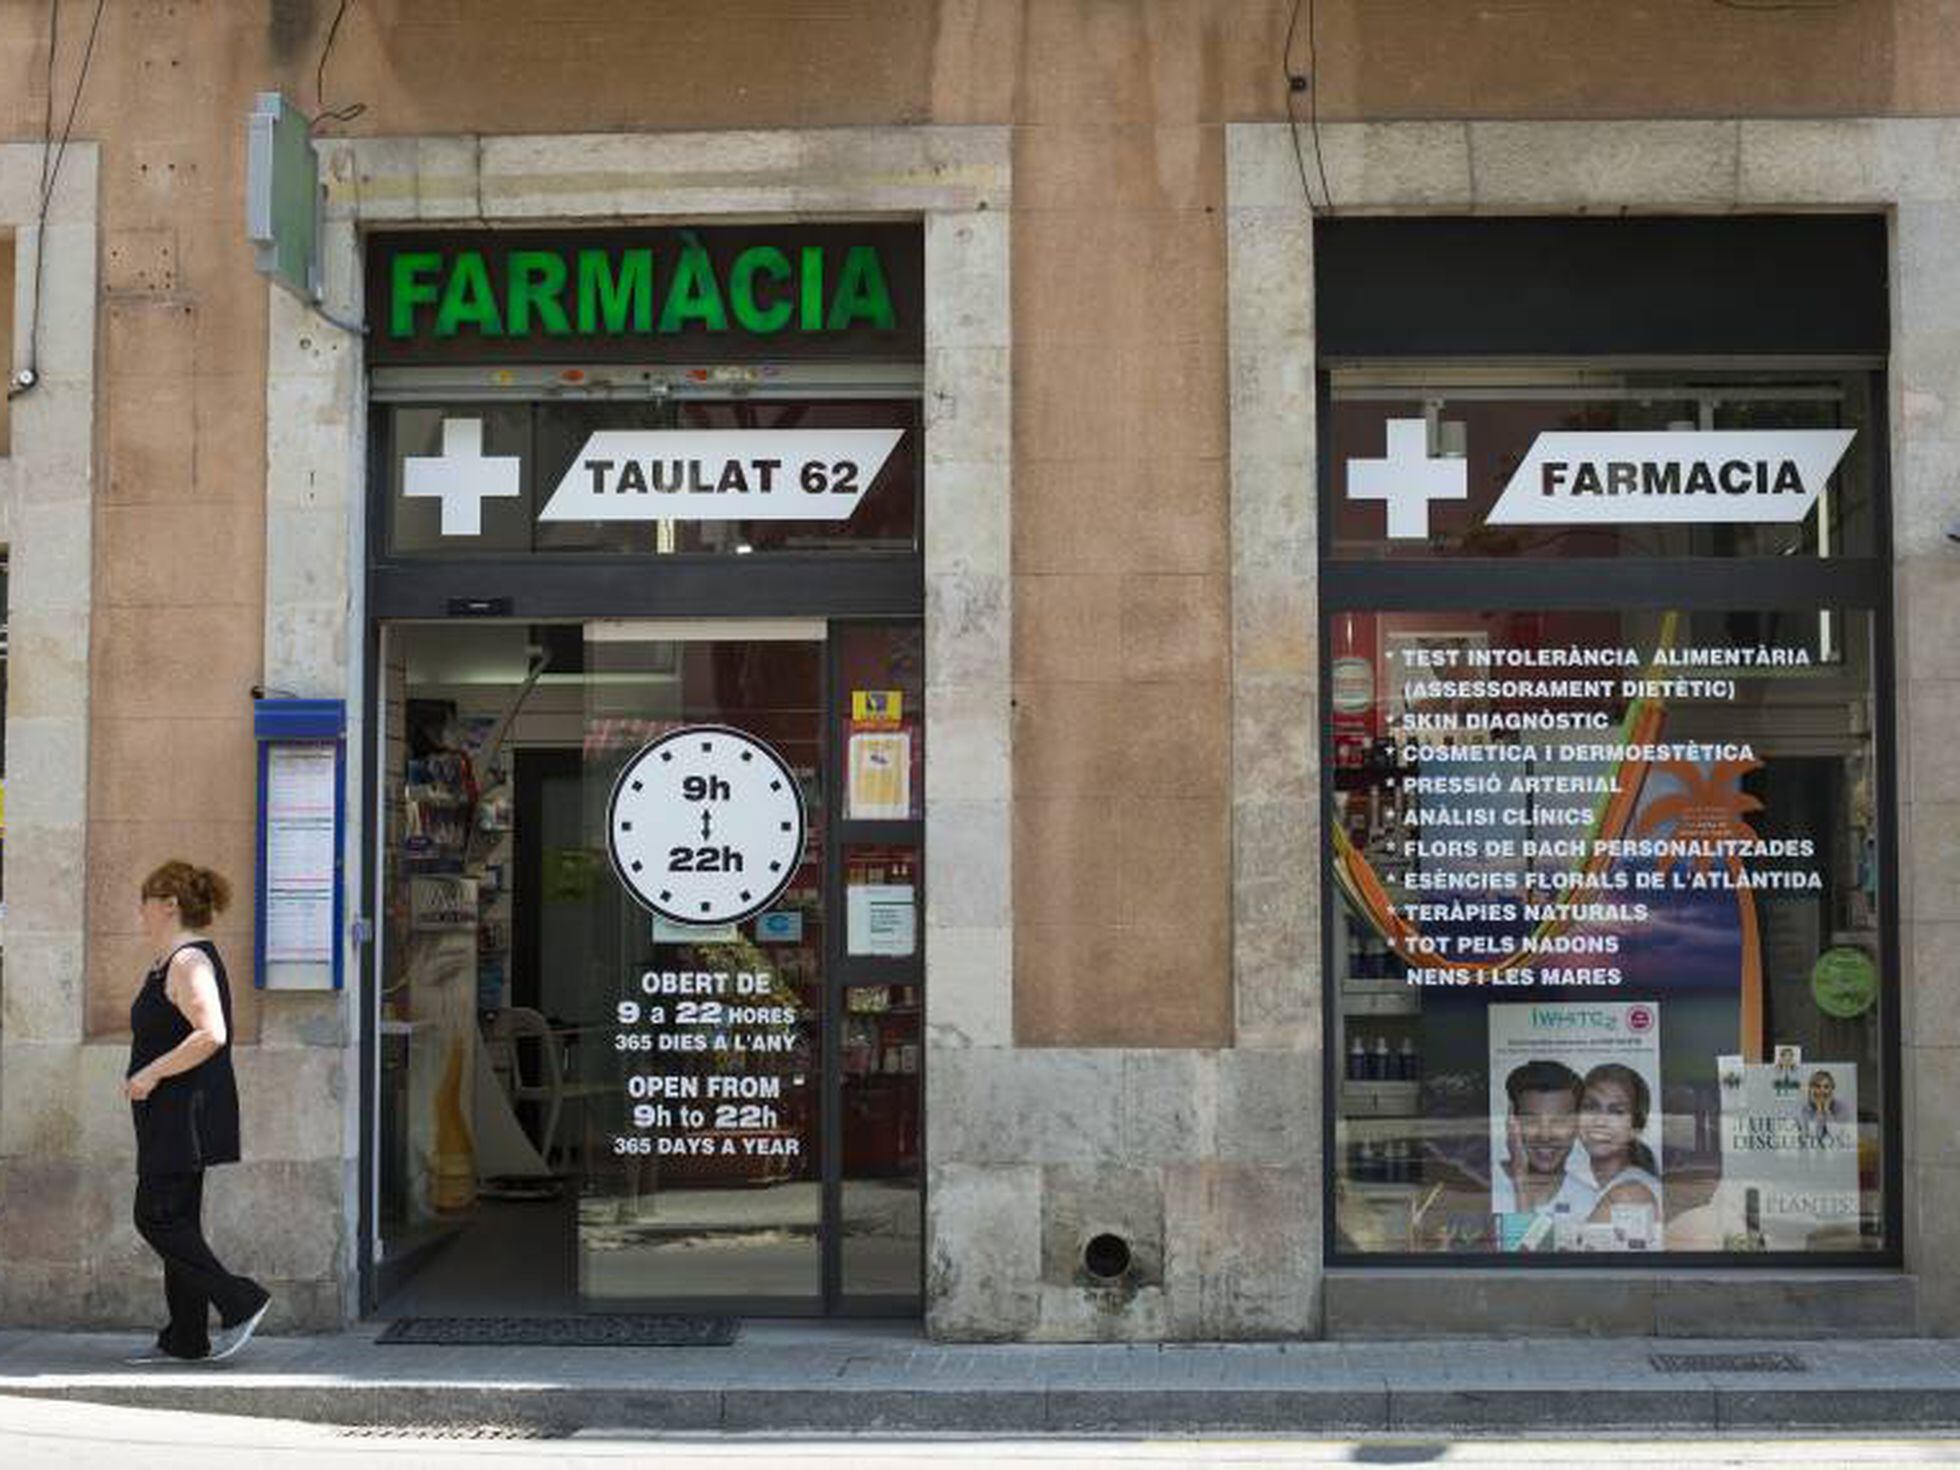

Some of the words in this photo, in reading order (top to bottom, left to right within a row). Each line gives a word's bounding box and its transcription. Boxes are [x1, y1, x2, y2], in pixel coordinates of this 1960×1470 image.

[389, 232, 897, 337] FARMÀCIA
[585, 460, 782, 494] TAULAT
[799, 461, 859, 494] 62
[1541, 460, 1806, 497] FARMACIA
[1402, 649, 1459, 667] TEST
[1468, 645, 1639, 667] INTOLERÀNCIA
[1653, 644, 1811, 666] ALIMENTÀRIA
[1404, 680, 1615, 700] (ASSESSORAMENT
[1622, 675, 1735, 700] DIETÈTIC)
[1402, 713, 1458, 730] SKIN
[1466, 708, 1609, 730] DIAGNÒSTIC
[1402, 744, 1537, 762] COSMETICA
[1545, 745, 1553, 761] I
[1559, 740, 1756, 762] DERMOESTÈTICA
[682, 774, 731, 801] 9h
[1402, 771, 1500, 794] PRESSIÓ
[1509, 775, 1622, 793] ARTERIAL
[1403, 803, 1496, 826] ANÀLISI
[1502, 803, 1596, 826] CLÍNICS
[1403, 840, 1478, 857] FLORS
[1486, 840, 1516, 857] DE
[1522, 840, 1586, 857] BACH
[1593, 839, 1815, 857] PERSONALITZADES
[668, 846, 744, 873] 22h
[1525, 872, 1628, 889] FLORALS
[1636, 872, 1665, 889] DE
[1673, 867, 1823, 889] L'ATLÀNTIDA
[1404, 900, 1517, 921] TERÀPIES
[1524, 904, 1649, 921] NATURALS
[1404, 936, 1451, 954] TOT
[1457, 936, 1515, 954] PELS
[1522, 936, 1620, 954] NADONS
[641, 972, 729, 994] OBERT
[736, 972, 772, 994] DE
[1406, 968, 1471, 986] NENS
[1476, 968, 1485, 985] I
[1491, 968, 1535, 985] LES
[1541, 968, 1623, 986] MARES
[617, 1001, 641, 1024] 9
[651, 1006, 666, 1024] a
[675, 1001, 723, 1024] 22
[728, 1007, 796, 1024] HORES
[614, 1034, 652, 1051] 365
[658, 1034, 707, 1051] DIES
[714, 1034, 730, 1051] A
[735, 1034, 797, 1051] L'ANY
[628, 1076, 698, 1098] OPEN
[706, 1076, 781, 1098] FROM
[633, 1104, 672, 1128] 9h
[680, 1105, 705, 1128] to
[714, 1104, 778, 1128] 22h
[614, 1137, 652, 1155] 365
[657, 1137, 715, 1155] DAYS
[721, 1137, 737, 1155] A
[743, 1137, 800, 1155] YEAR
